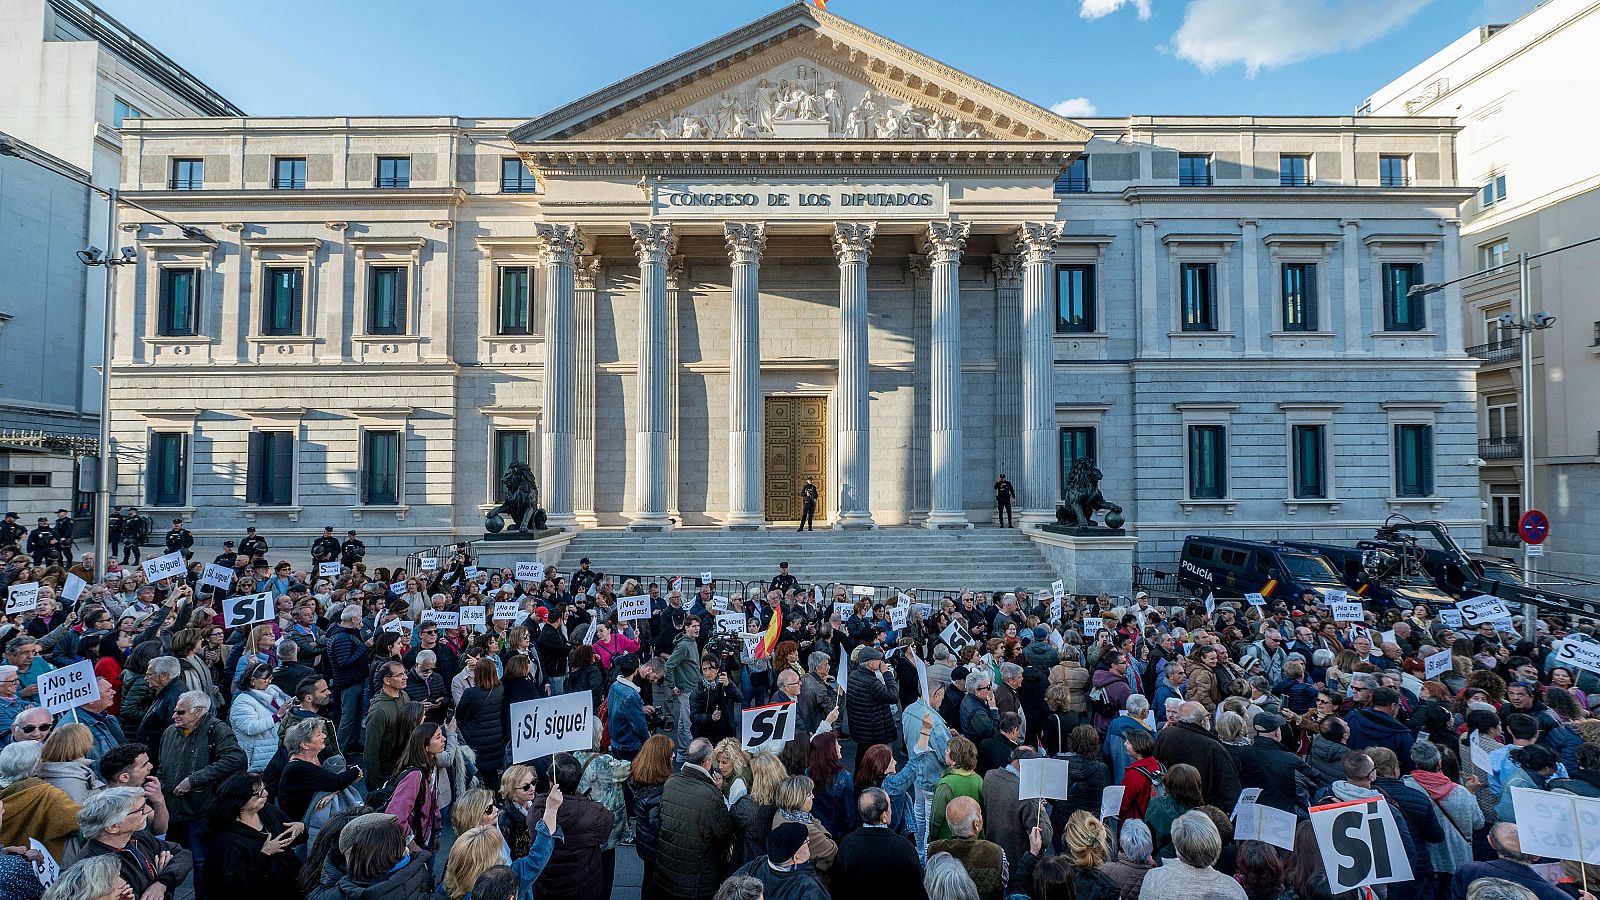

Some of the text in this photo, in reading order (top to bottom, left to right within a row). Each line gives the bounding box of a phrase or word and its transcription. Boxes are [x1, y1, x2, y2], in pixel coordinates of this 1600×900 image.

[670, 193, 932, 206] CONGRESO DE LOS DIPUTADOS
[160, 557, 180, 573] sigue!
[1182, 560, 1212, 581] POLICÍA
[230, 593, 266, 626] SÍ
[619, 600, 633, 610] ¡No
[620, 608, 647, 617] rindas!
[1493, 604, 1504, 614] SÍ
[738, 624, 745, 633] SÍ
[950, 621, 971, 655] SÍ
[43, 670, 83, 695] ¡No te
[47, 682, 92, 707] rindas!
[544, 706, 588, 740] sigue!
[747, 704, 790, 747] SÍ
[1332, 801, 1393, 887] SÍ
